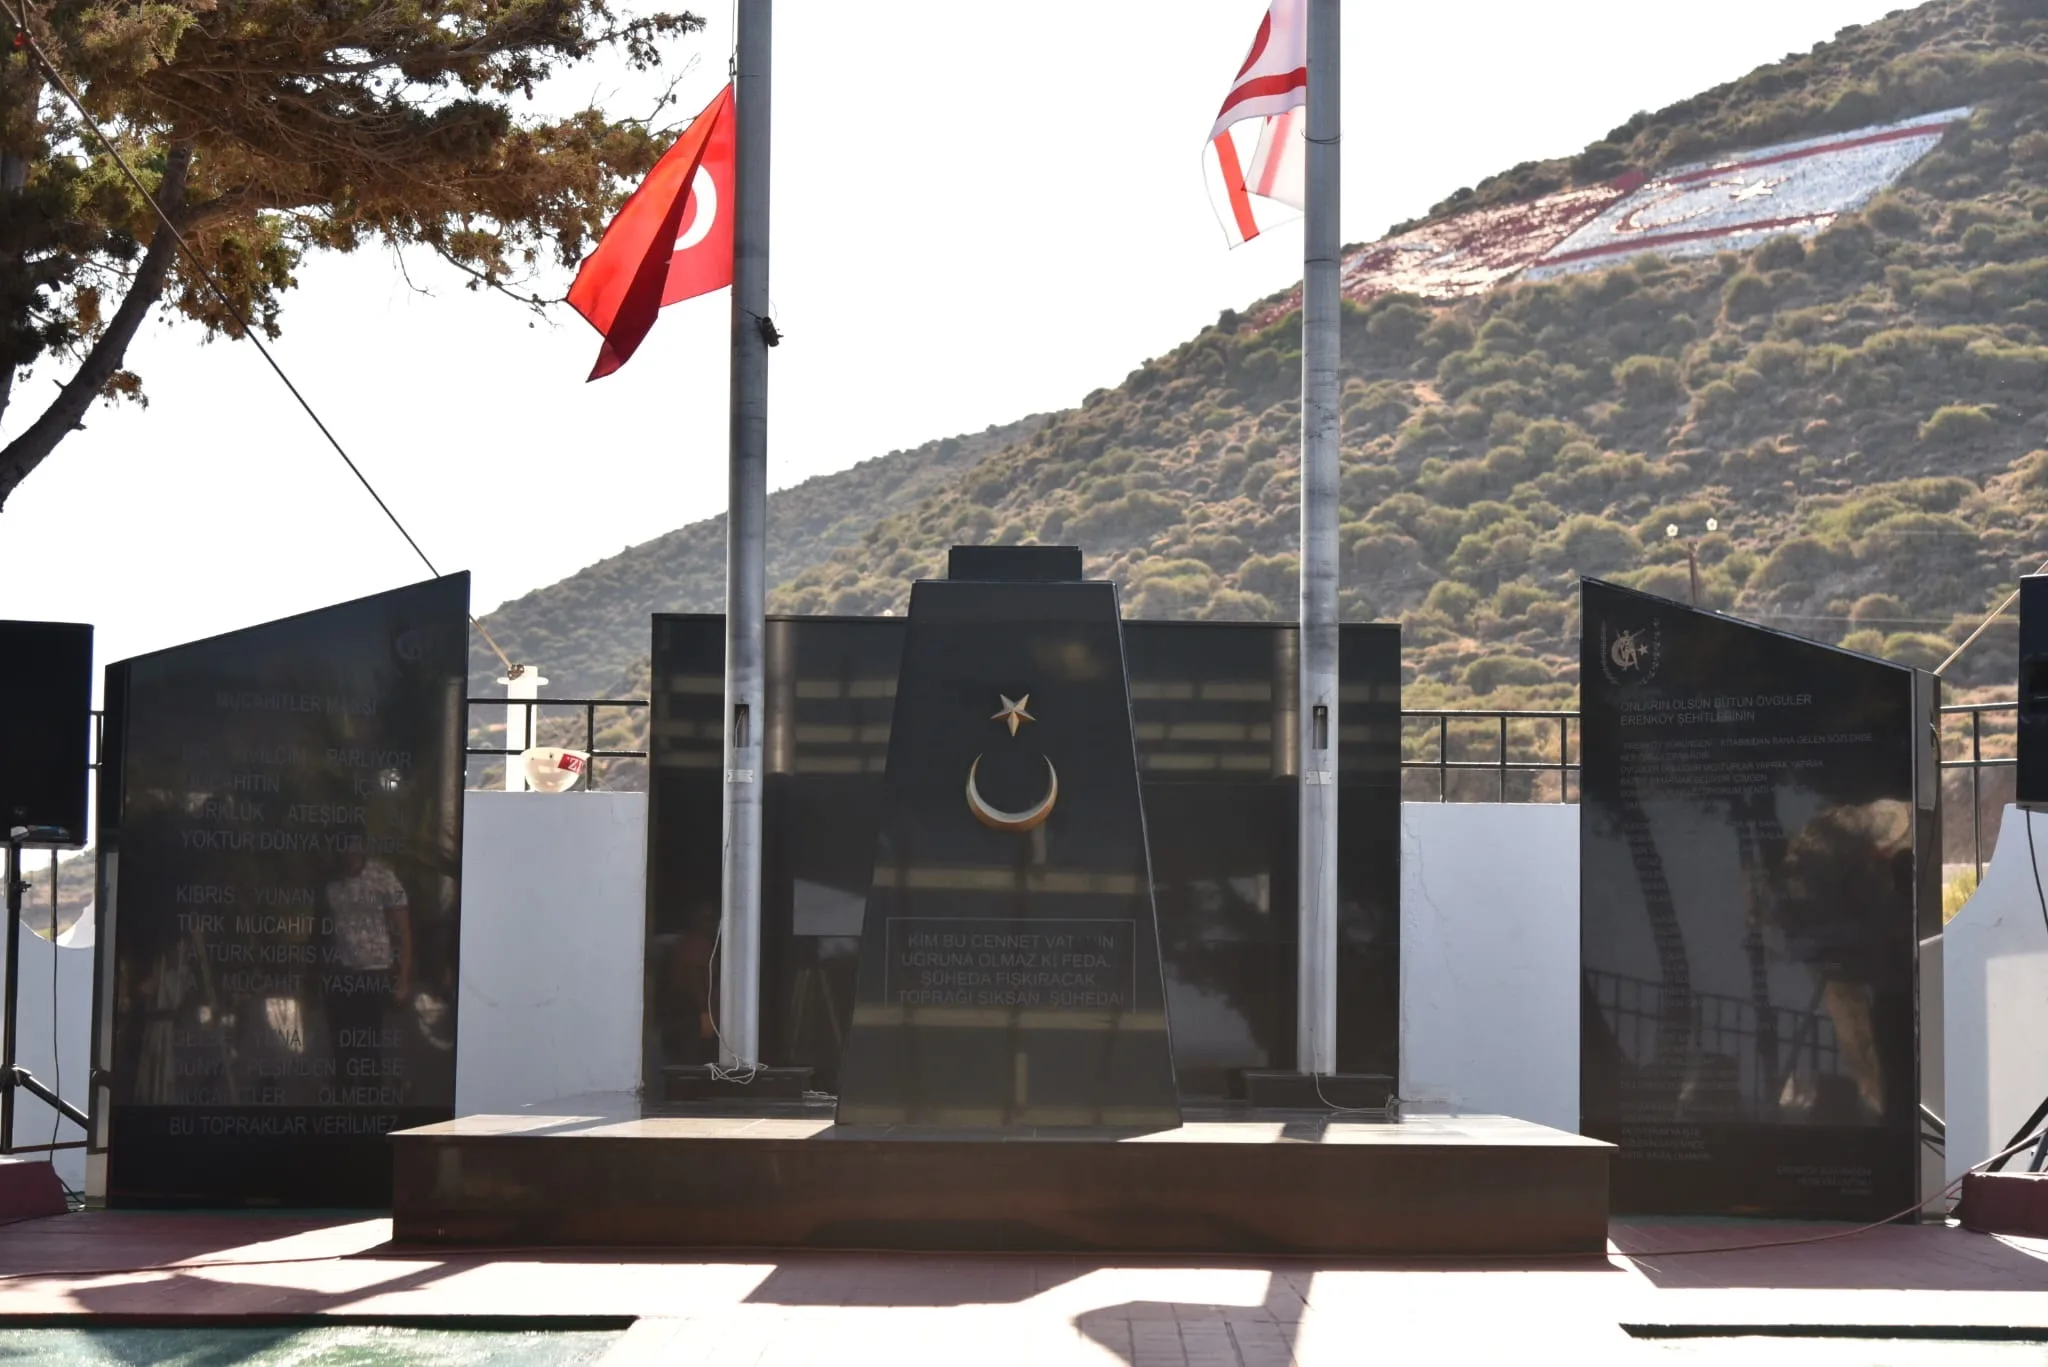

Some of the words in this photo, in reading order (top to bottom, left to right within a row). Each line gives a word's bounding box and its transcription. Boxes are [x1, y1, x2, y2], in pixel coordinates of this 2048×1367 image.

[181, 829, 255, 851] YOKTUR
[260, 828, 320, 851] DÜNYA
[176, 884, 235, 904] KIBRIS
[252, 886, 315, 905] YUNAN
[176, 911, 225, 933] TÜRK
[943, 934, 967, 948] BU
[971, 934, 1041, 949] CENNET
[1044, 934, 1114, 949] VATIN
[259, 944, 317, 965] KIBRIS
[979, 952, 1039, 968] OLMAZ
[346, 1057, 405, 1077] GELSE
[169, 1115, 194, 1136] BU
[200, 1114, 308, 1137] TOPRAKLAR
